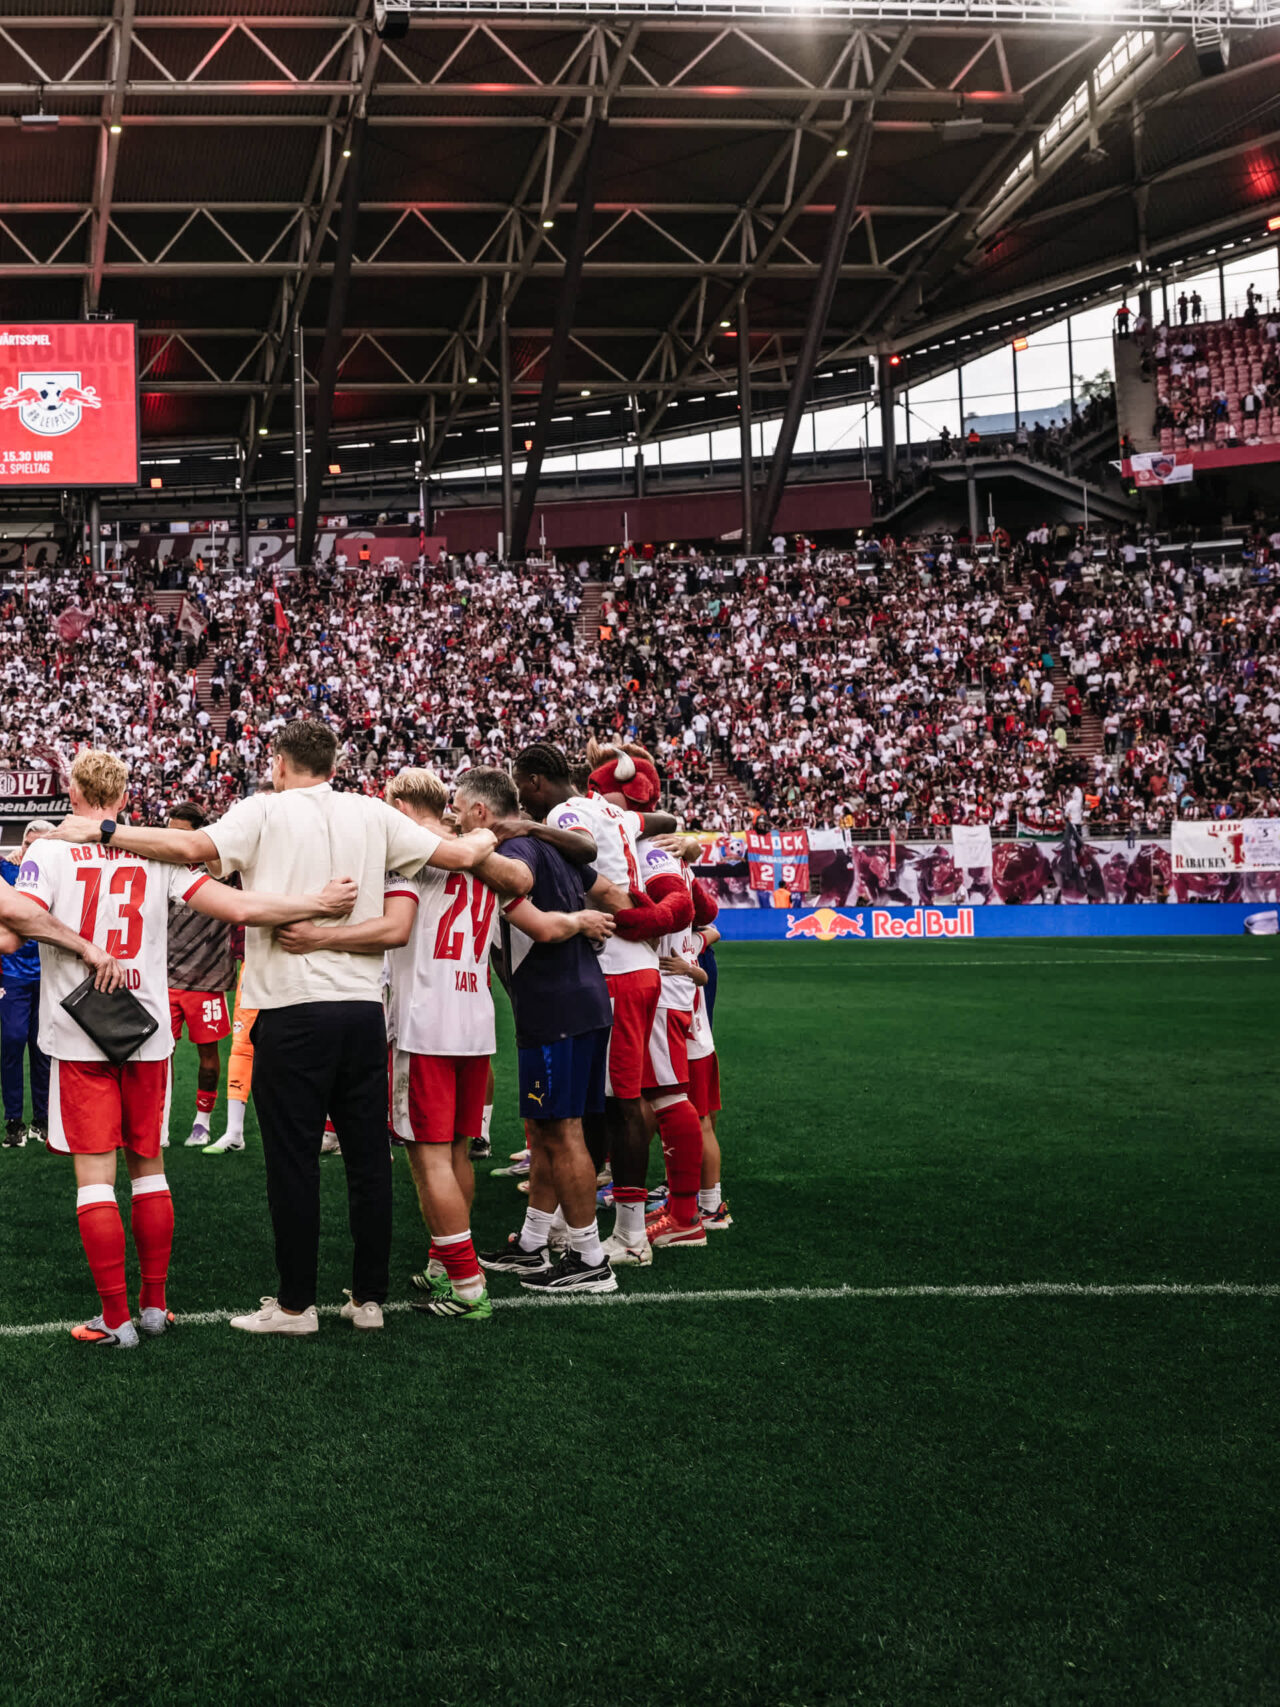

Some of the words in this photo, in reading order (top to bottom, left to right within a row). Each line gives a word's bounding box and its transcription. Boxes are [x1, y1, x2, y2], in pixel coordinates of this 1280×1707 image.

[3, 451, 31, 462] 15.30
[33, 451, 53, 461] UHR
[0, 464, 8, 474] 3.
[10, 463, 50, 474] SPIELTAG
[18, 773, 52, 795] 147
[749, 834, 804, 850] BLOCK
[70, 846, 93, 862] RB
[76, 866, 147, 960] 13
[433, 871, 496, 964] 24
[872, 909, 923, 937] Red
[925, 908, 974, 936] Bull
[202, 999, 222, 1022] 35
